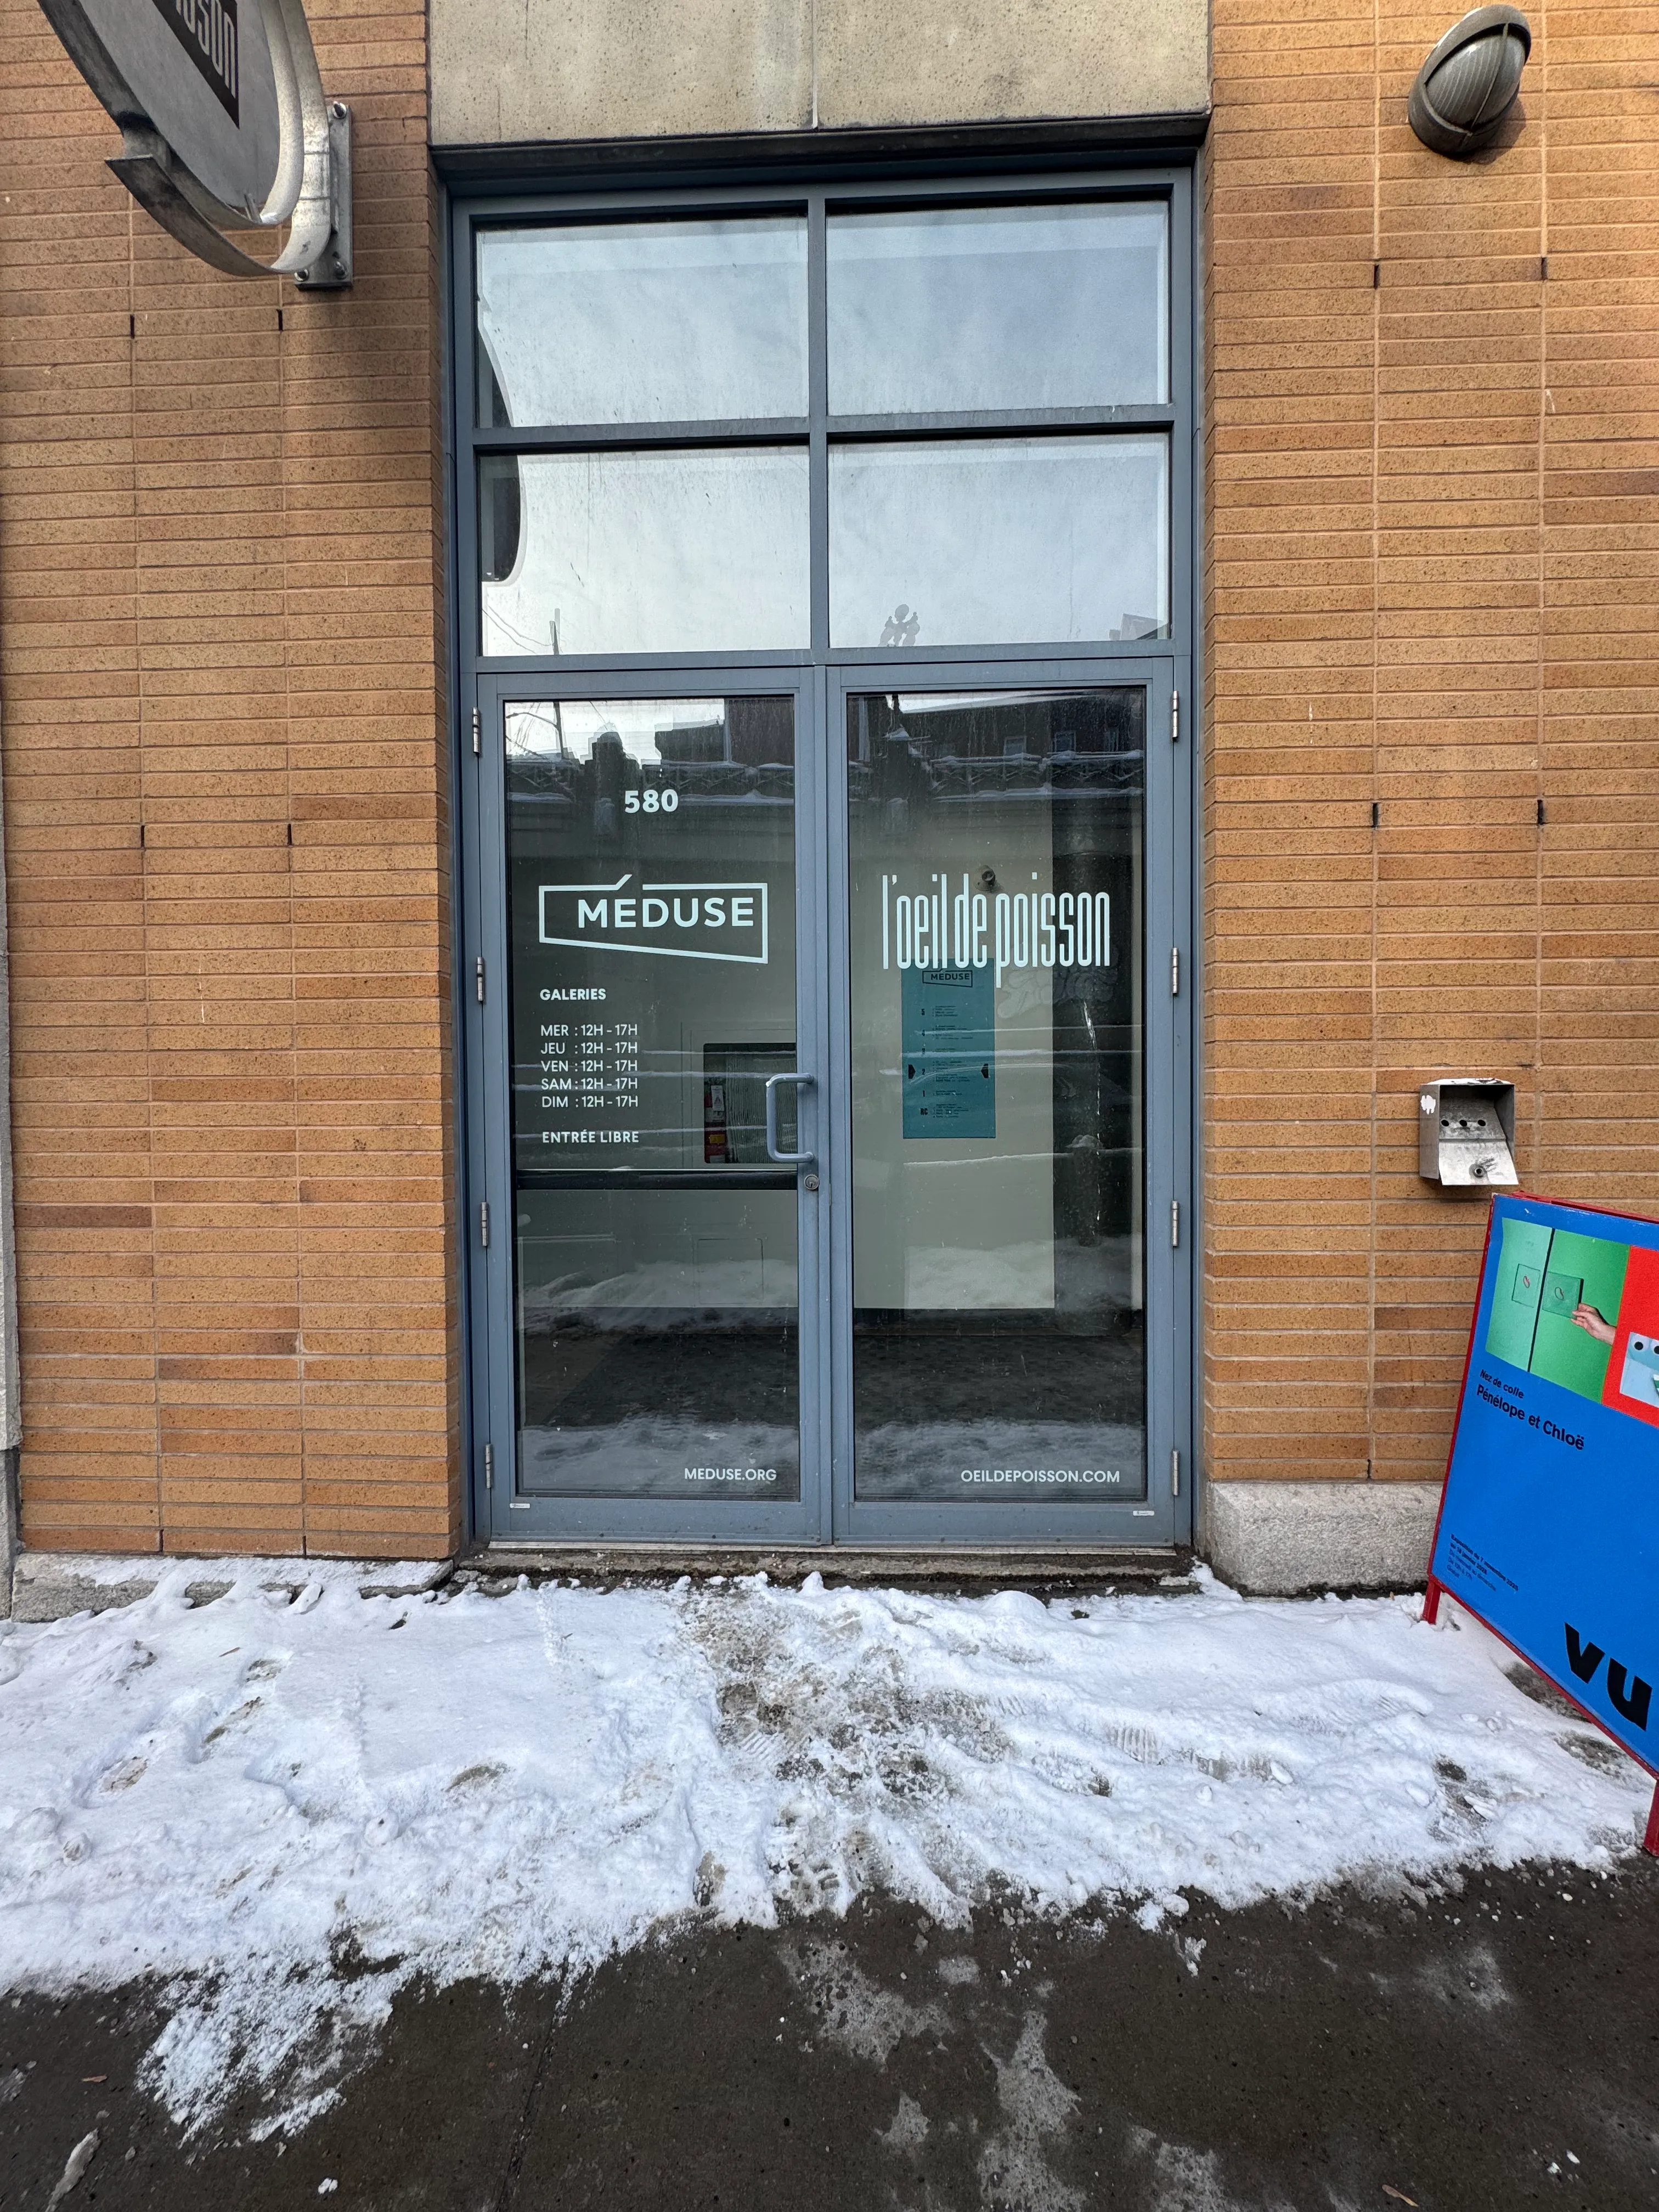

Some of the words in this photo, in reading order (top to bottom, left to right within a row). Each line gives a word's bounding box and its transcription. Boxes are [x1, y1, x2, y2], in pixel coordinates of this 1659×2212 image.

[176, 0, 236, 98] son
[624, 789, 679, 814] 580
[882, 873, 947, 969] l'oeil
[954, 873, 987, 969] de
[995, 872, 1110, 988] poisson
[540, 989, 606, 1001] GALERIES
[540, 1025, 569, 1036] MER
[580, 1024, 603, 1036] 12H
[614, 1024, 638, 1036] 17H
[540, 1042, 565, 1054] JEU
[580, 1042, 603, 1054] 12H
[614, 1042, 638, 1054] 17H
[541, 1060, 568, 1072] VEN
[580, 1060, 603, 1072] 12H
[614, 1060, 638, 1072] 17H
[541, 1078, 572, 1090] SAM
[580, 1077, 603, 1090] 12H
[614, 1077, 638, 1090] 17H
[542, 1096, 568, 1108] DIM
[581, 1096, 604, 1108] 12H
[615, 1096, 639, 1108] 17H
[543, 1129, 596, 1143] ENTRÉE
[600, 1131, 639, 1143] LIBRE
[1480, 1369, 1492, 1383] Nez
[1493, 1378, 1502, 1388] de
[1503, 1384, 1524, 1399] colle
[1476, 1384, 1525, 1420] Pénélope
[1528, 1414, 1541, 1429] et
[1543, 1420, 1584, 1451] Chloë
[684, 1468, 777, 1481] MEDUSE.ORG
[961, 1470, 1120, 1483] OEILDEPOISSON.COM
